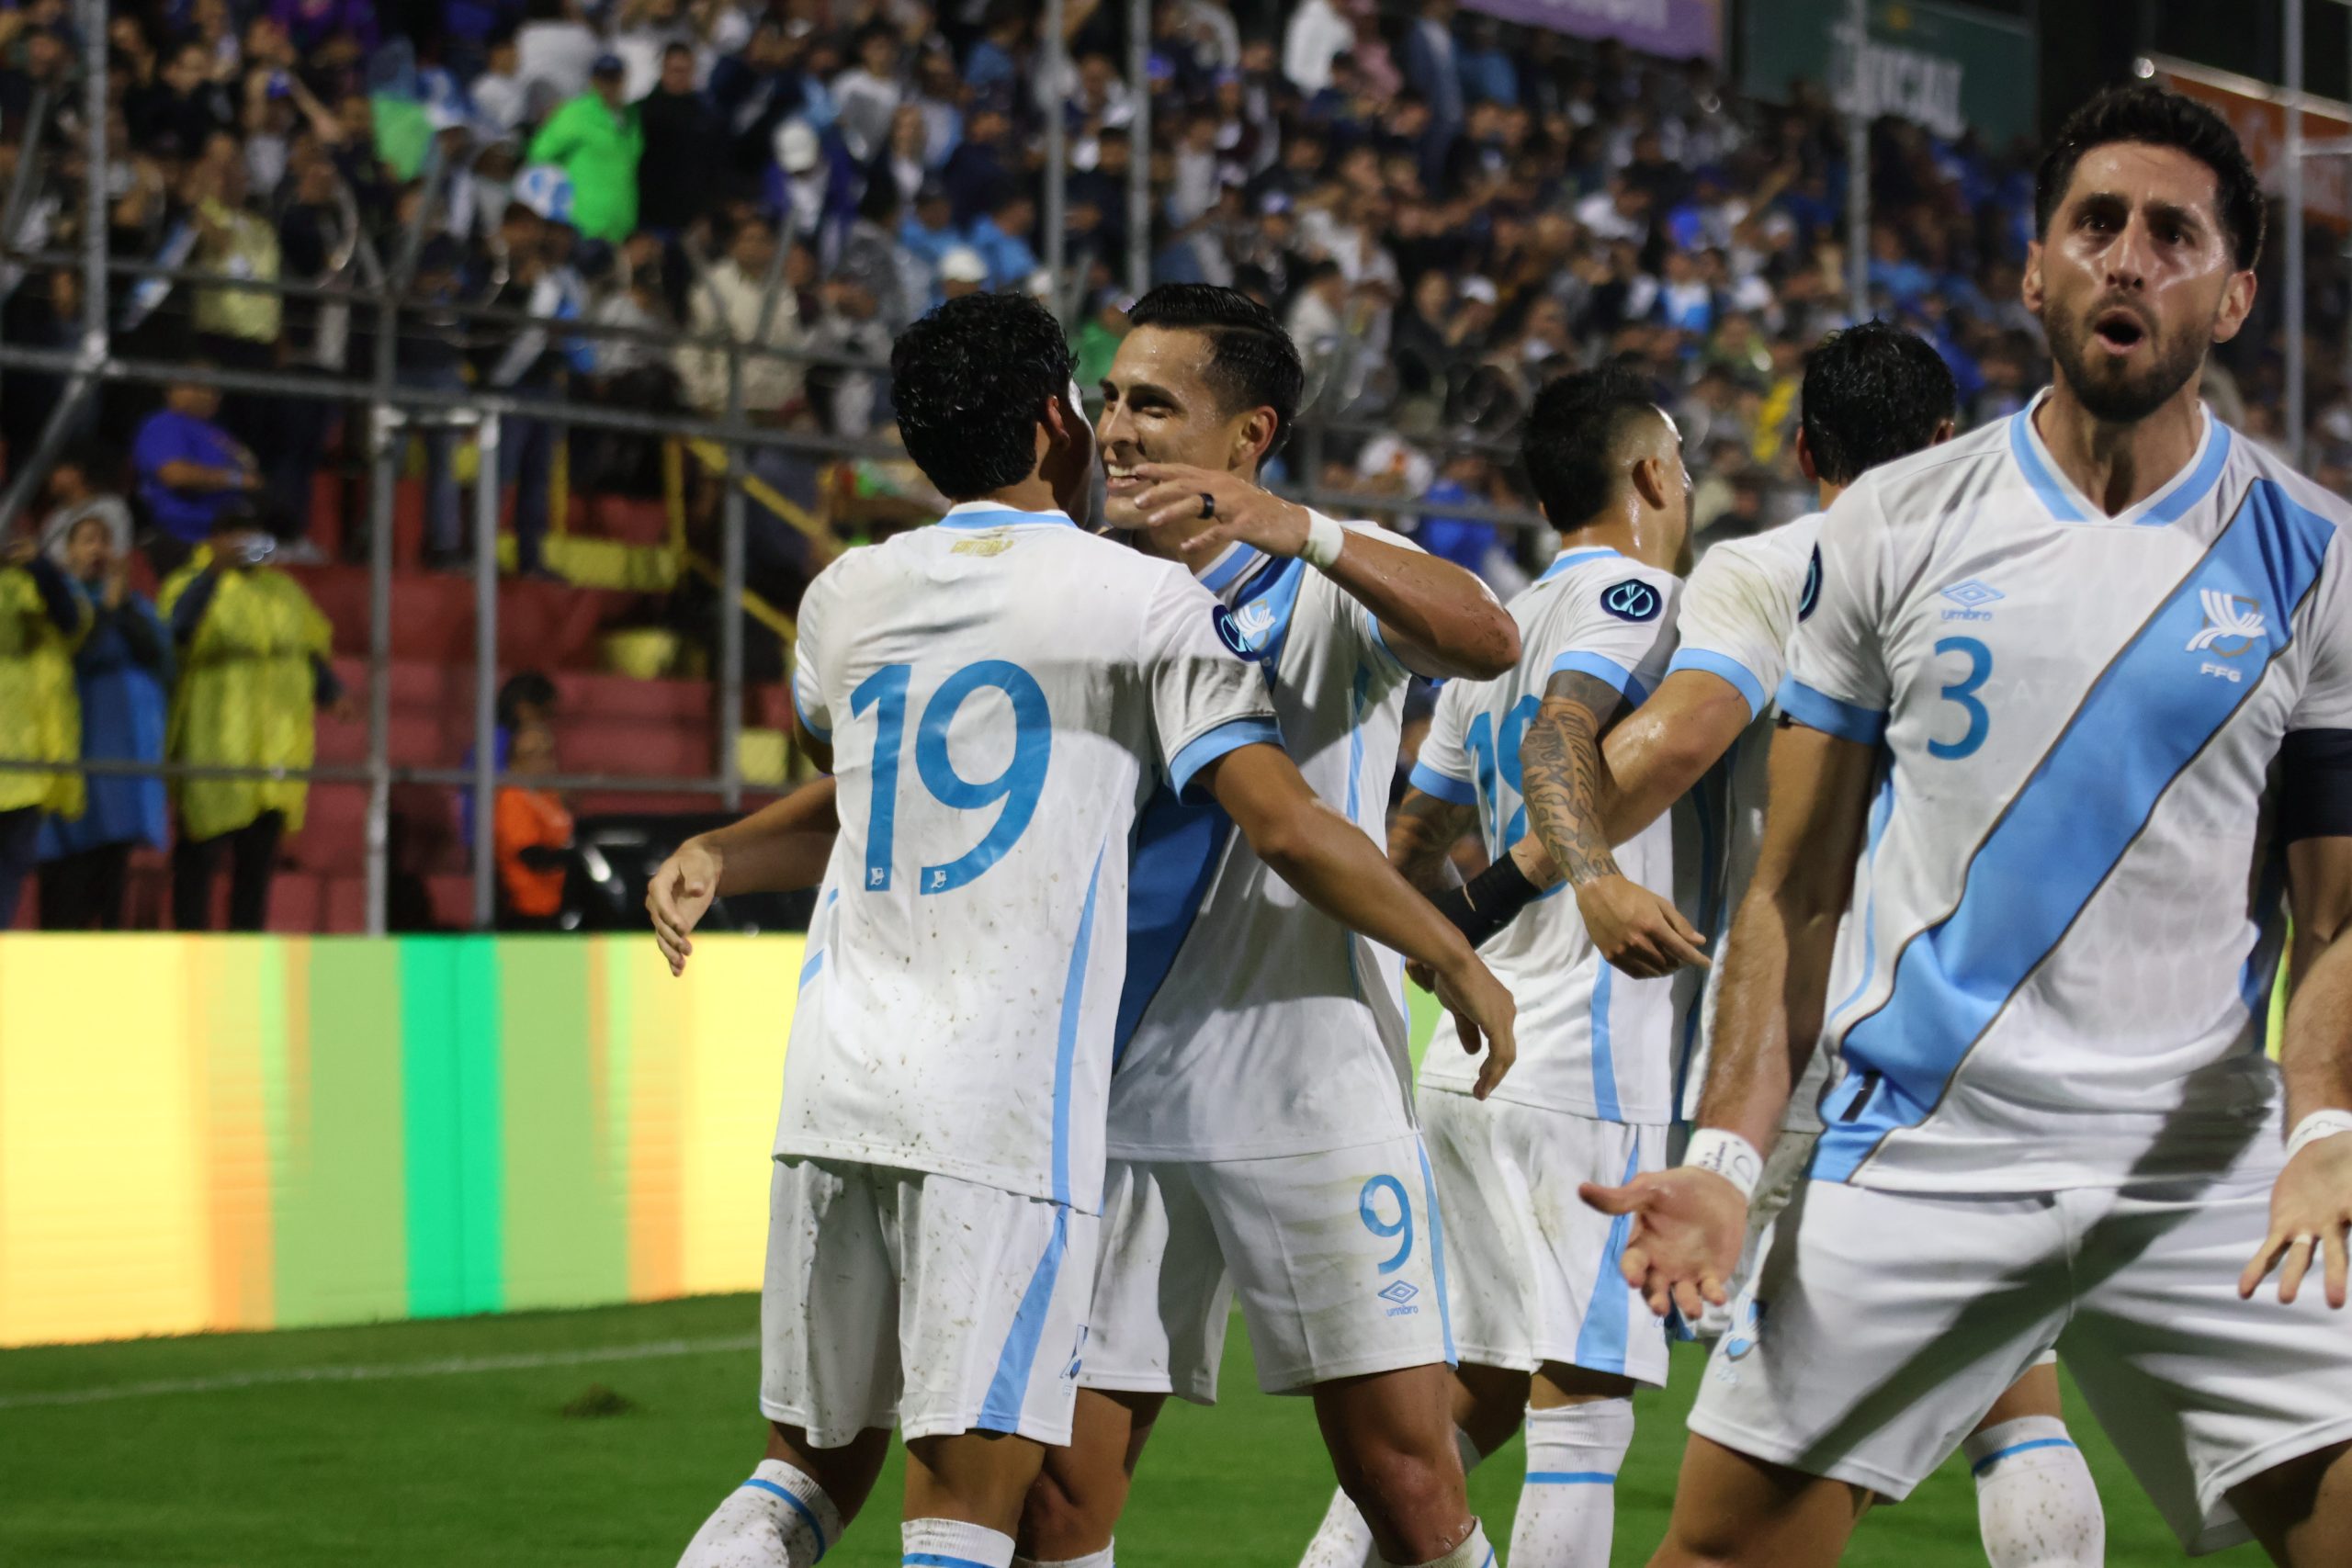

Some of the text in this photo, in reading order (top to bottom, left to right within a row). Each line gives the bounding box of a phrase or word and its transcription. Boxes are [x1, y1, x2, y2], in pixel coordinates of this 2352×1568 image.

[1940, 607, 1993, 622] umbro
[1927, 636, 1993, 761] 3
[2200, 662, 2241, 682] FFG
[850, 660, 1052, 896] 19
[1359, 1174, 1413, 1276] 9
[1386, 1304, 1419, 1316] umbro
